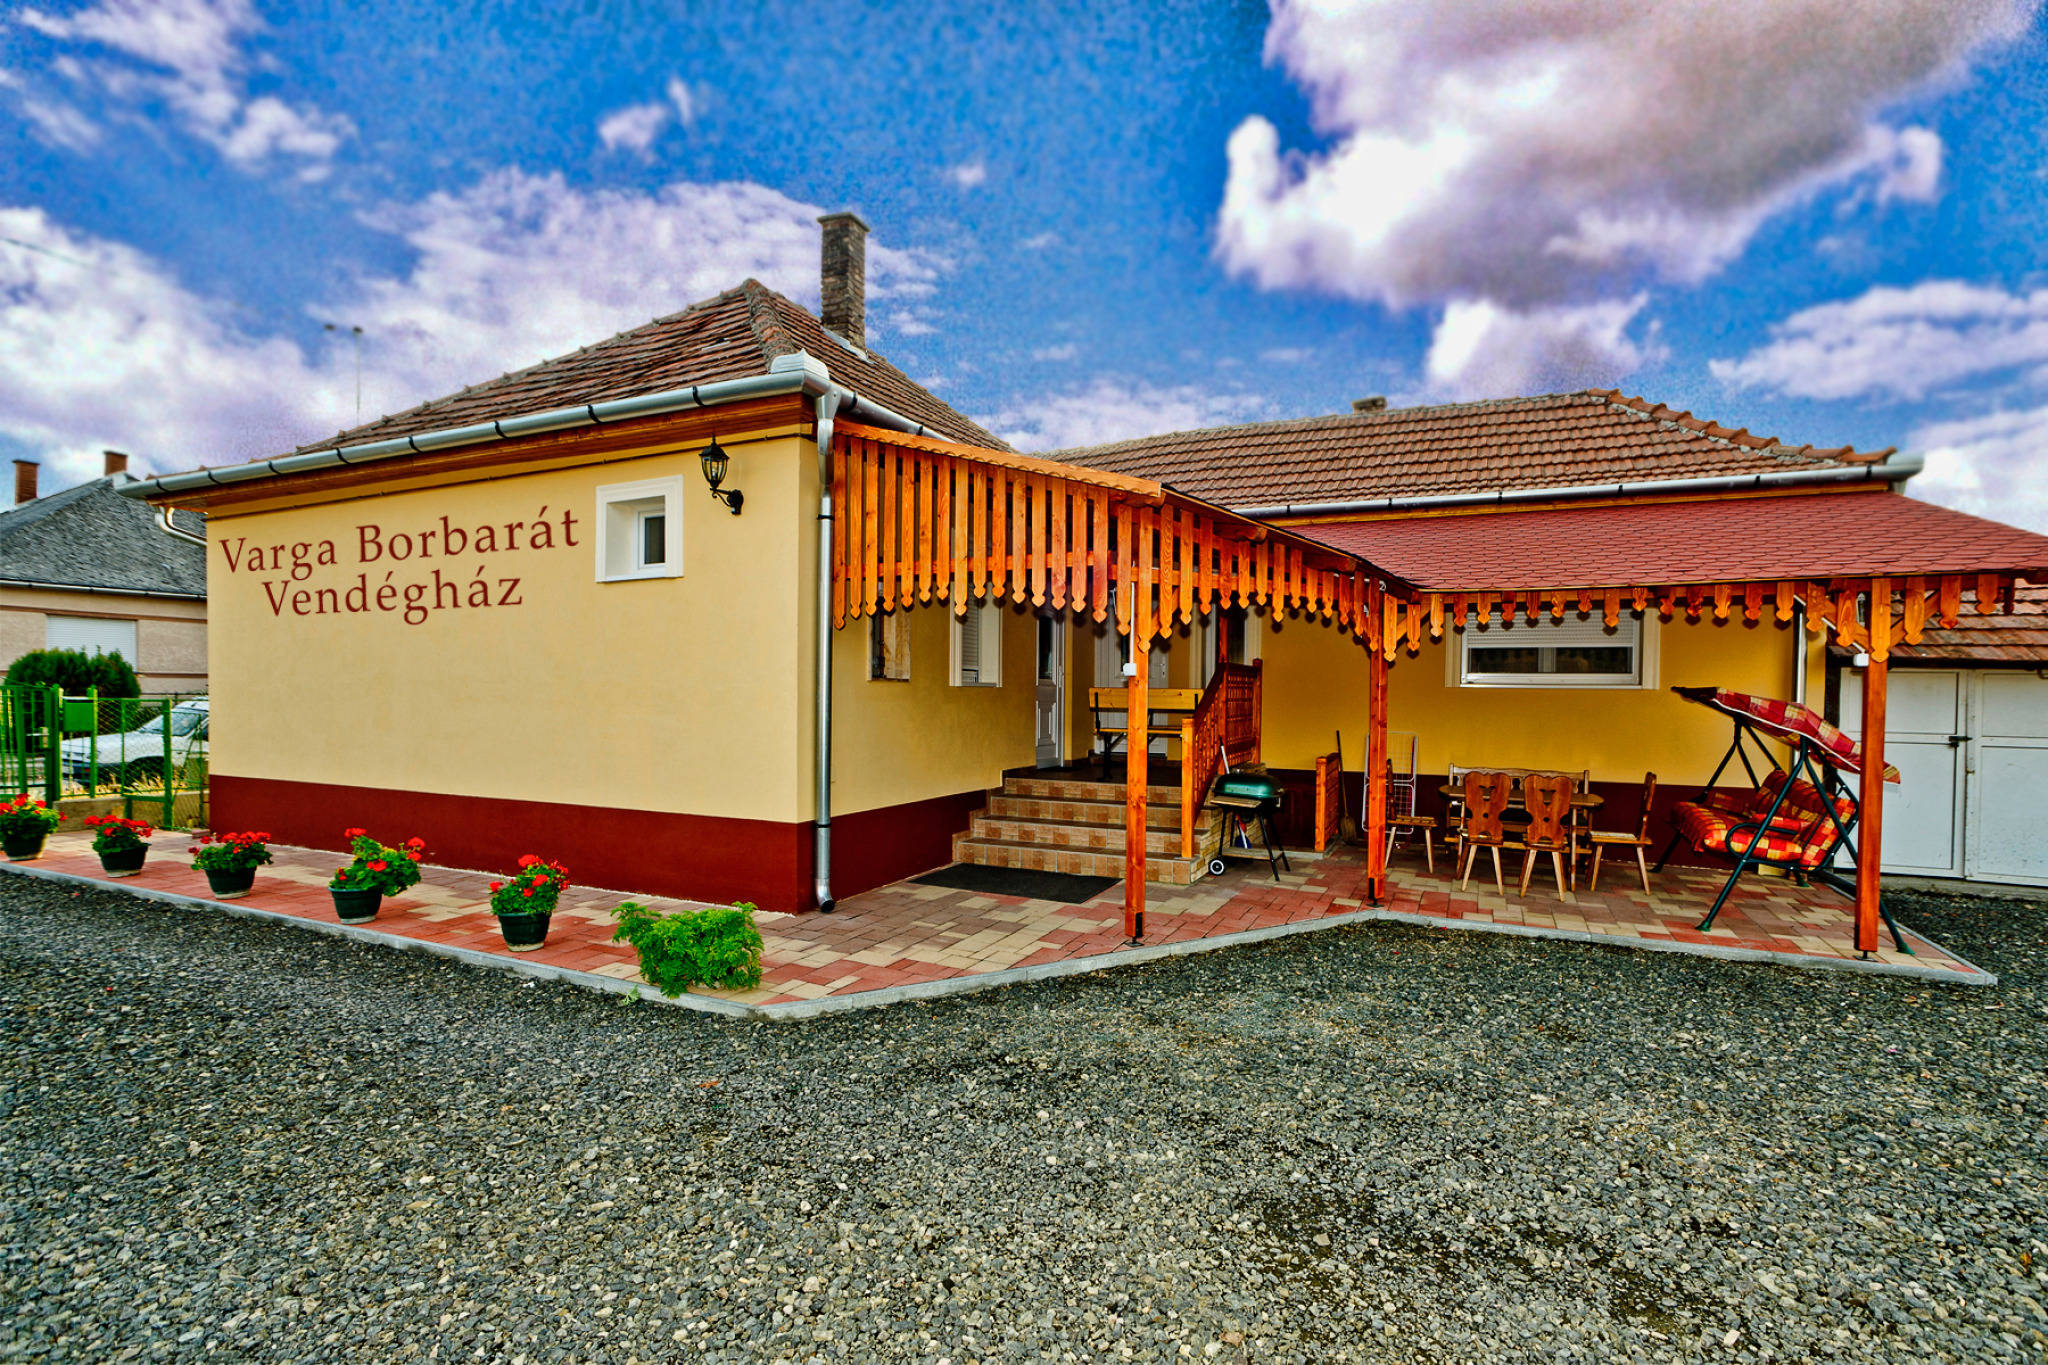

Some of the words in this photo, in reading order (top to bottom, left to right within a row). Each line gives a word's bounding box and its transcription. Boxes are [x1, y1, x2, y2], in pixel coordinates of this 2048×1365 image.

[218, 536, 338, 581] Varga
[355, 505, 580, 564] Borbarát
[262, 564, 524, 626] Vendégház
